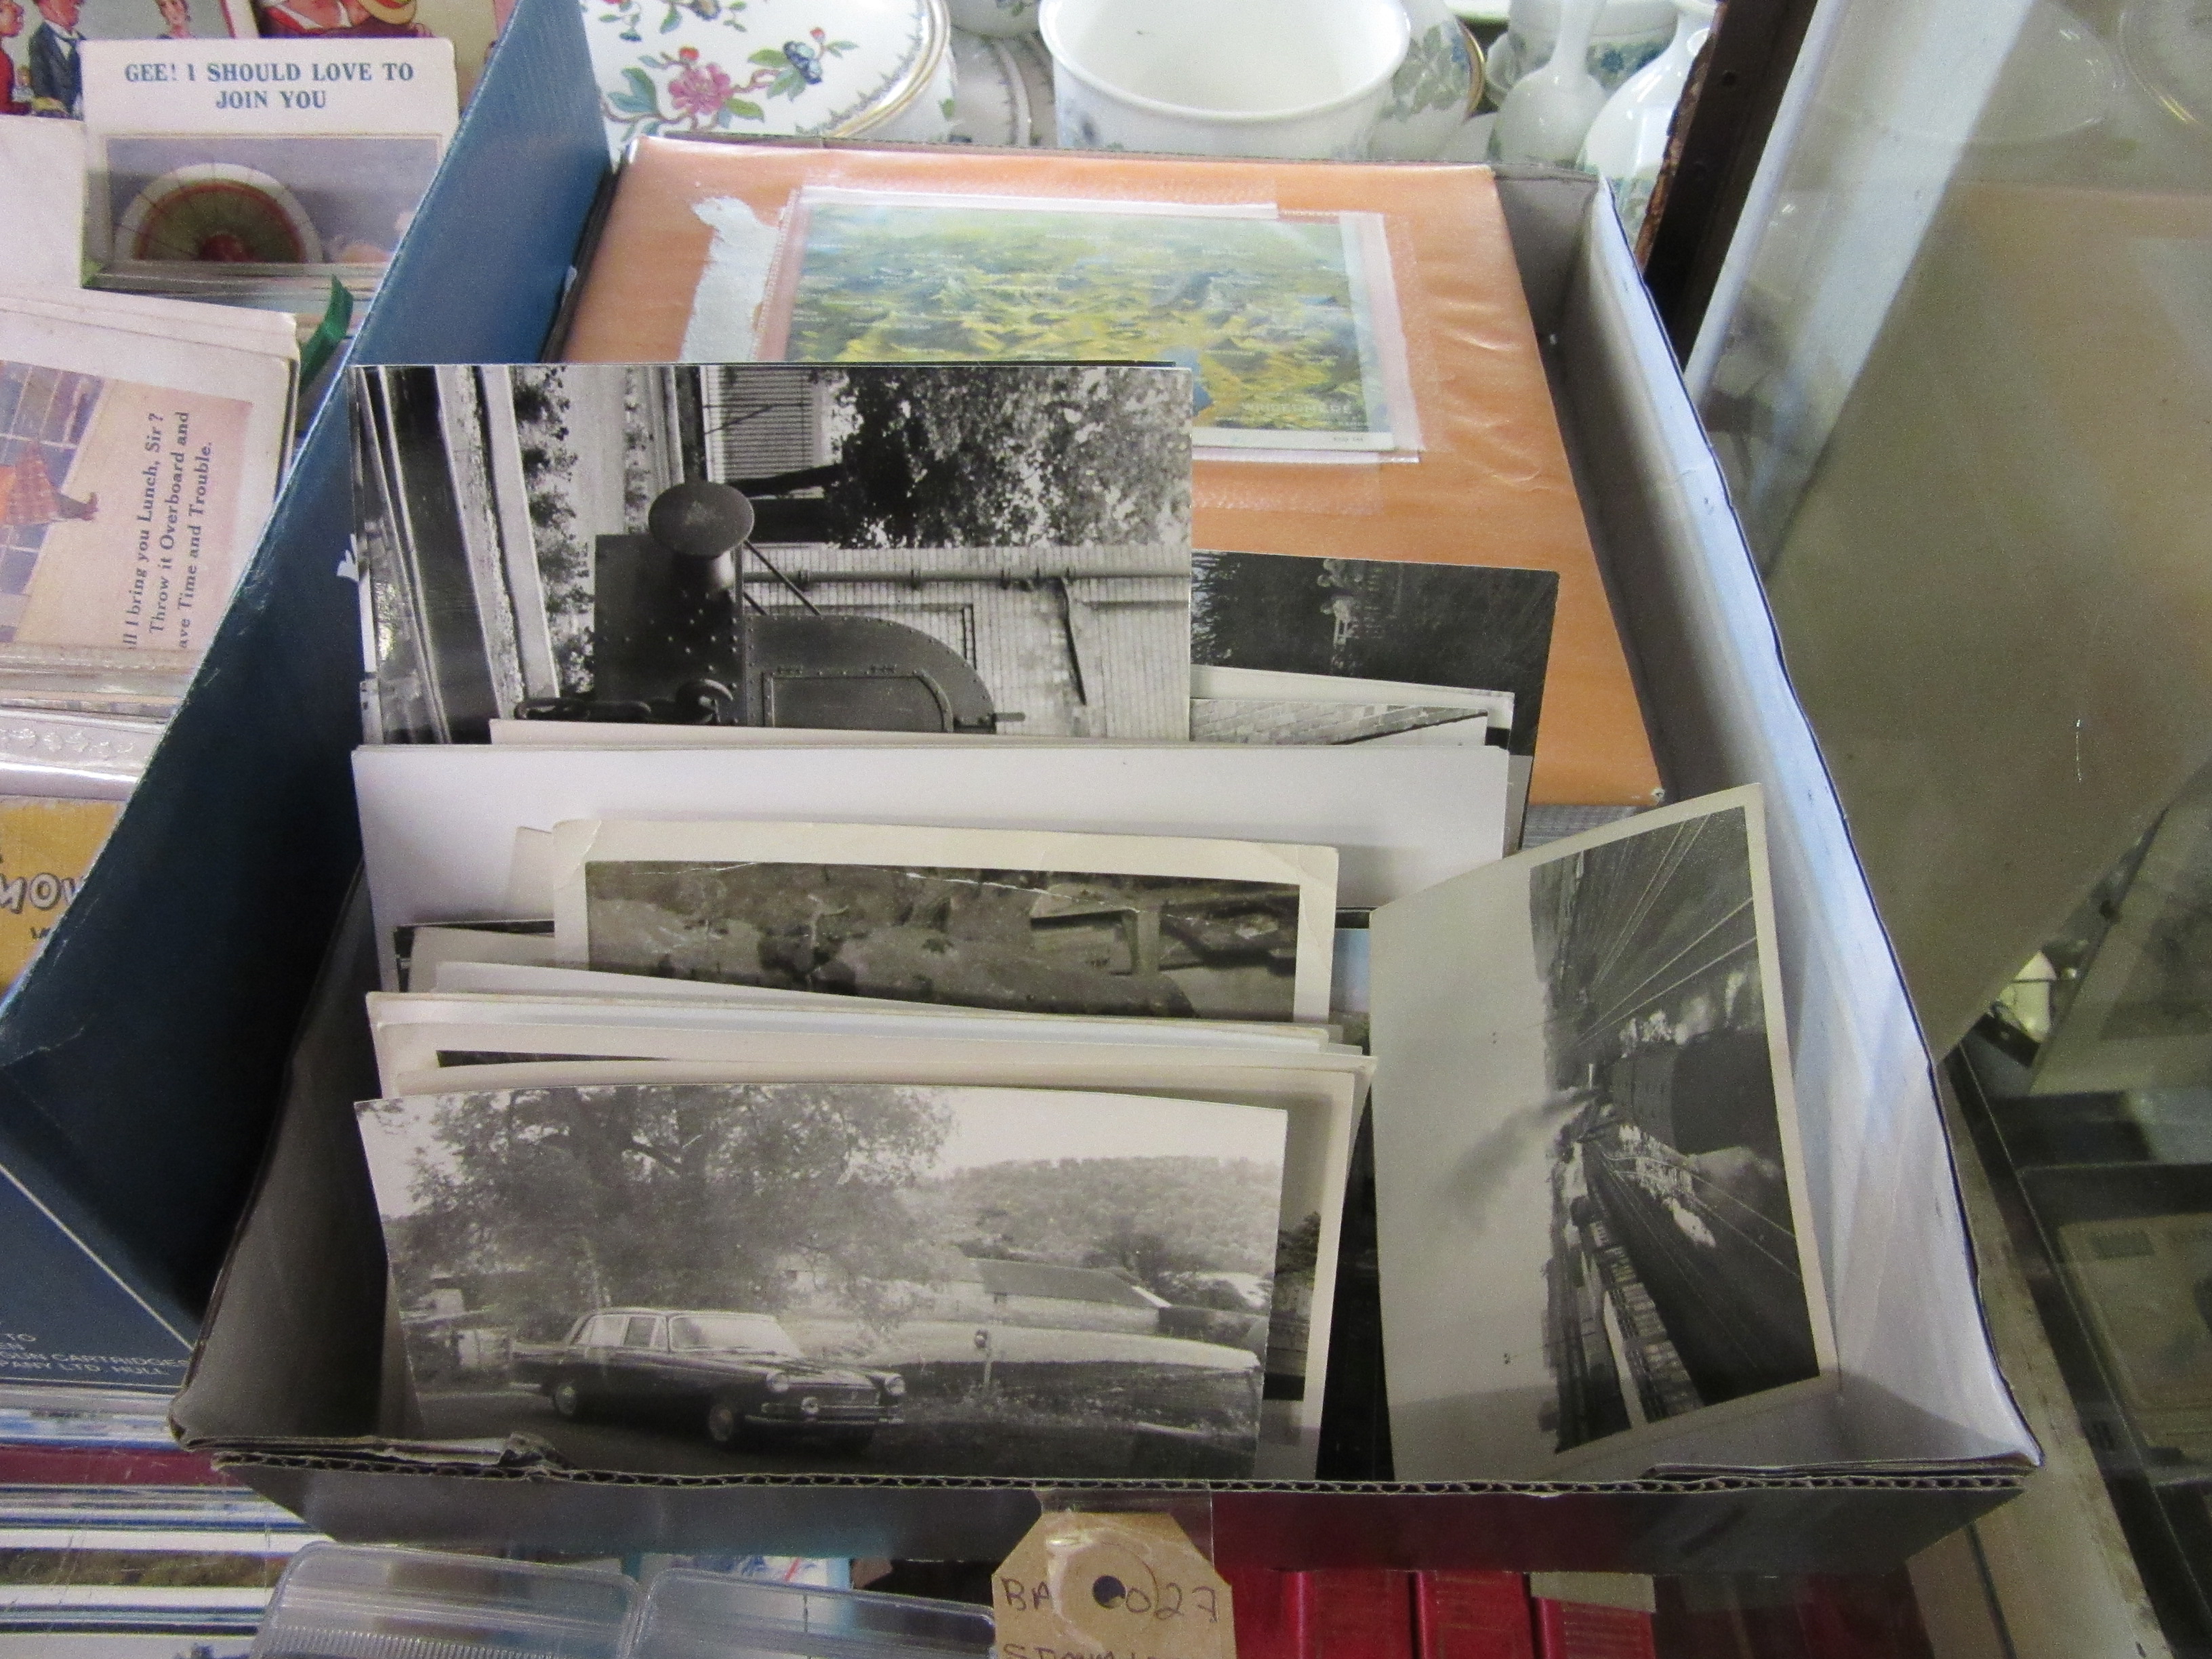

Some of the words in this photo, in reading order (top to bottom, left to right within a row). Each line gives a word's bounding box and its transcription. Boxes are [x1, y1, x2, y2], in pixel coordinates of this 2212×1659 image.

[124, 63, 177, 81] GEE!
[188, 63, 196, 81] I
[207, 62, 301, 81] SHOULD
[312, 62, 372, 81] LOVE
[382, 62, 414, 81] TO
[216, 90, 268, 108] JOIN
[280, 90, 326, 108] YOU
[176, 411, 189, 446] and
[137, 460, 161, 522] Lunch,
[188, 442, 212, 516] Trouble.
[160, 451, 184, 550] Overboard
[137, 529, 150, 562] you
[187, 525, 201, 558] and
[159, 558, 172, 570] it
[126, 569, 148, 615] bring
[150, 577, 170, 634] Throw
[178, 565, 197, 609] Time
